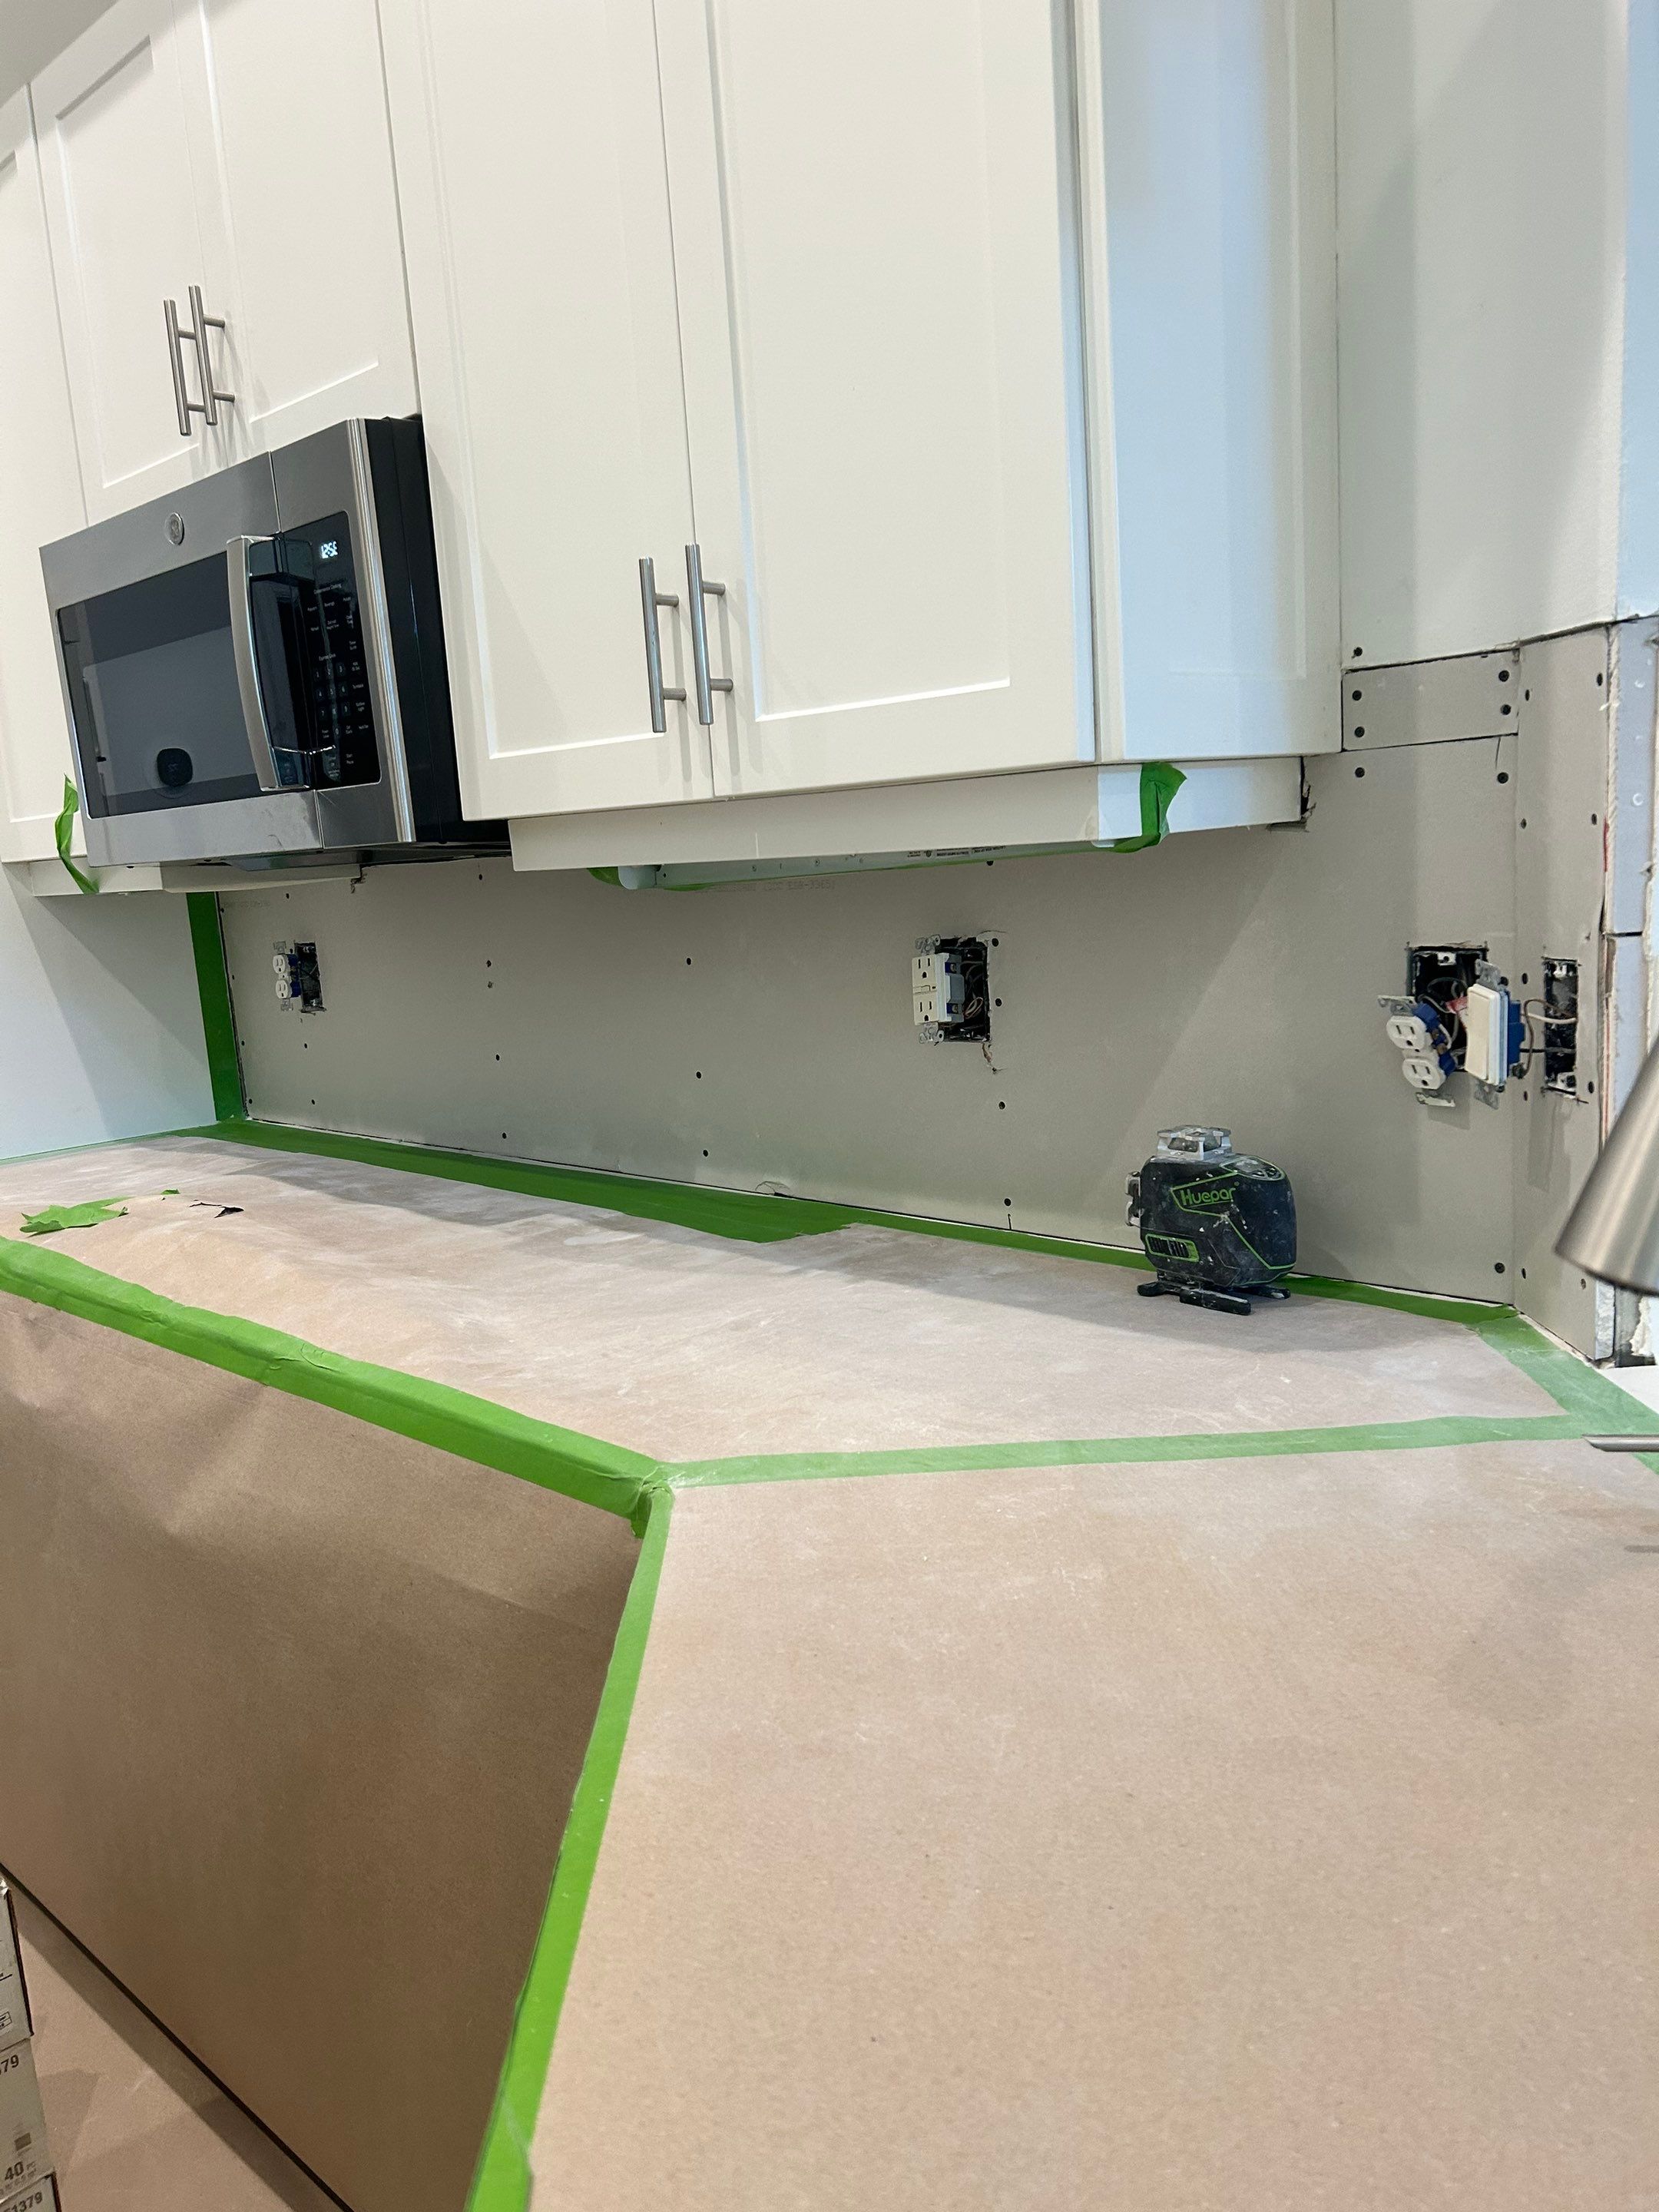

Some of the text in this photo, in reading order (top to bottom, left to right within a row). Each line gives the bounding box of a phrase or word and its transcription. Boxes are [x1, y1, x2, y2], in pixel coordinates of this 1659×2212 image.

[1180, 1187, 1236, 1206] Huepar
[0, 2055, 19, 2076] 79
[5, 2161, 24, 2180] 40
